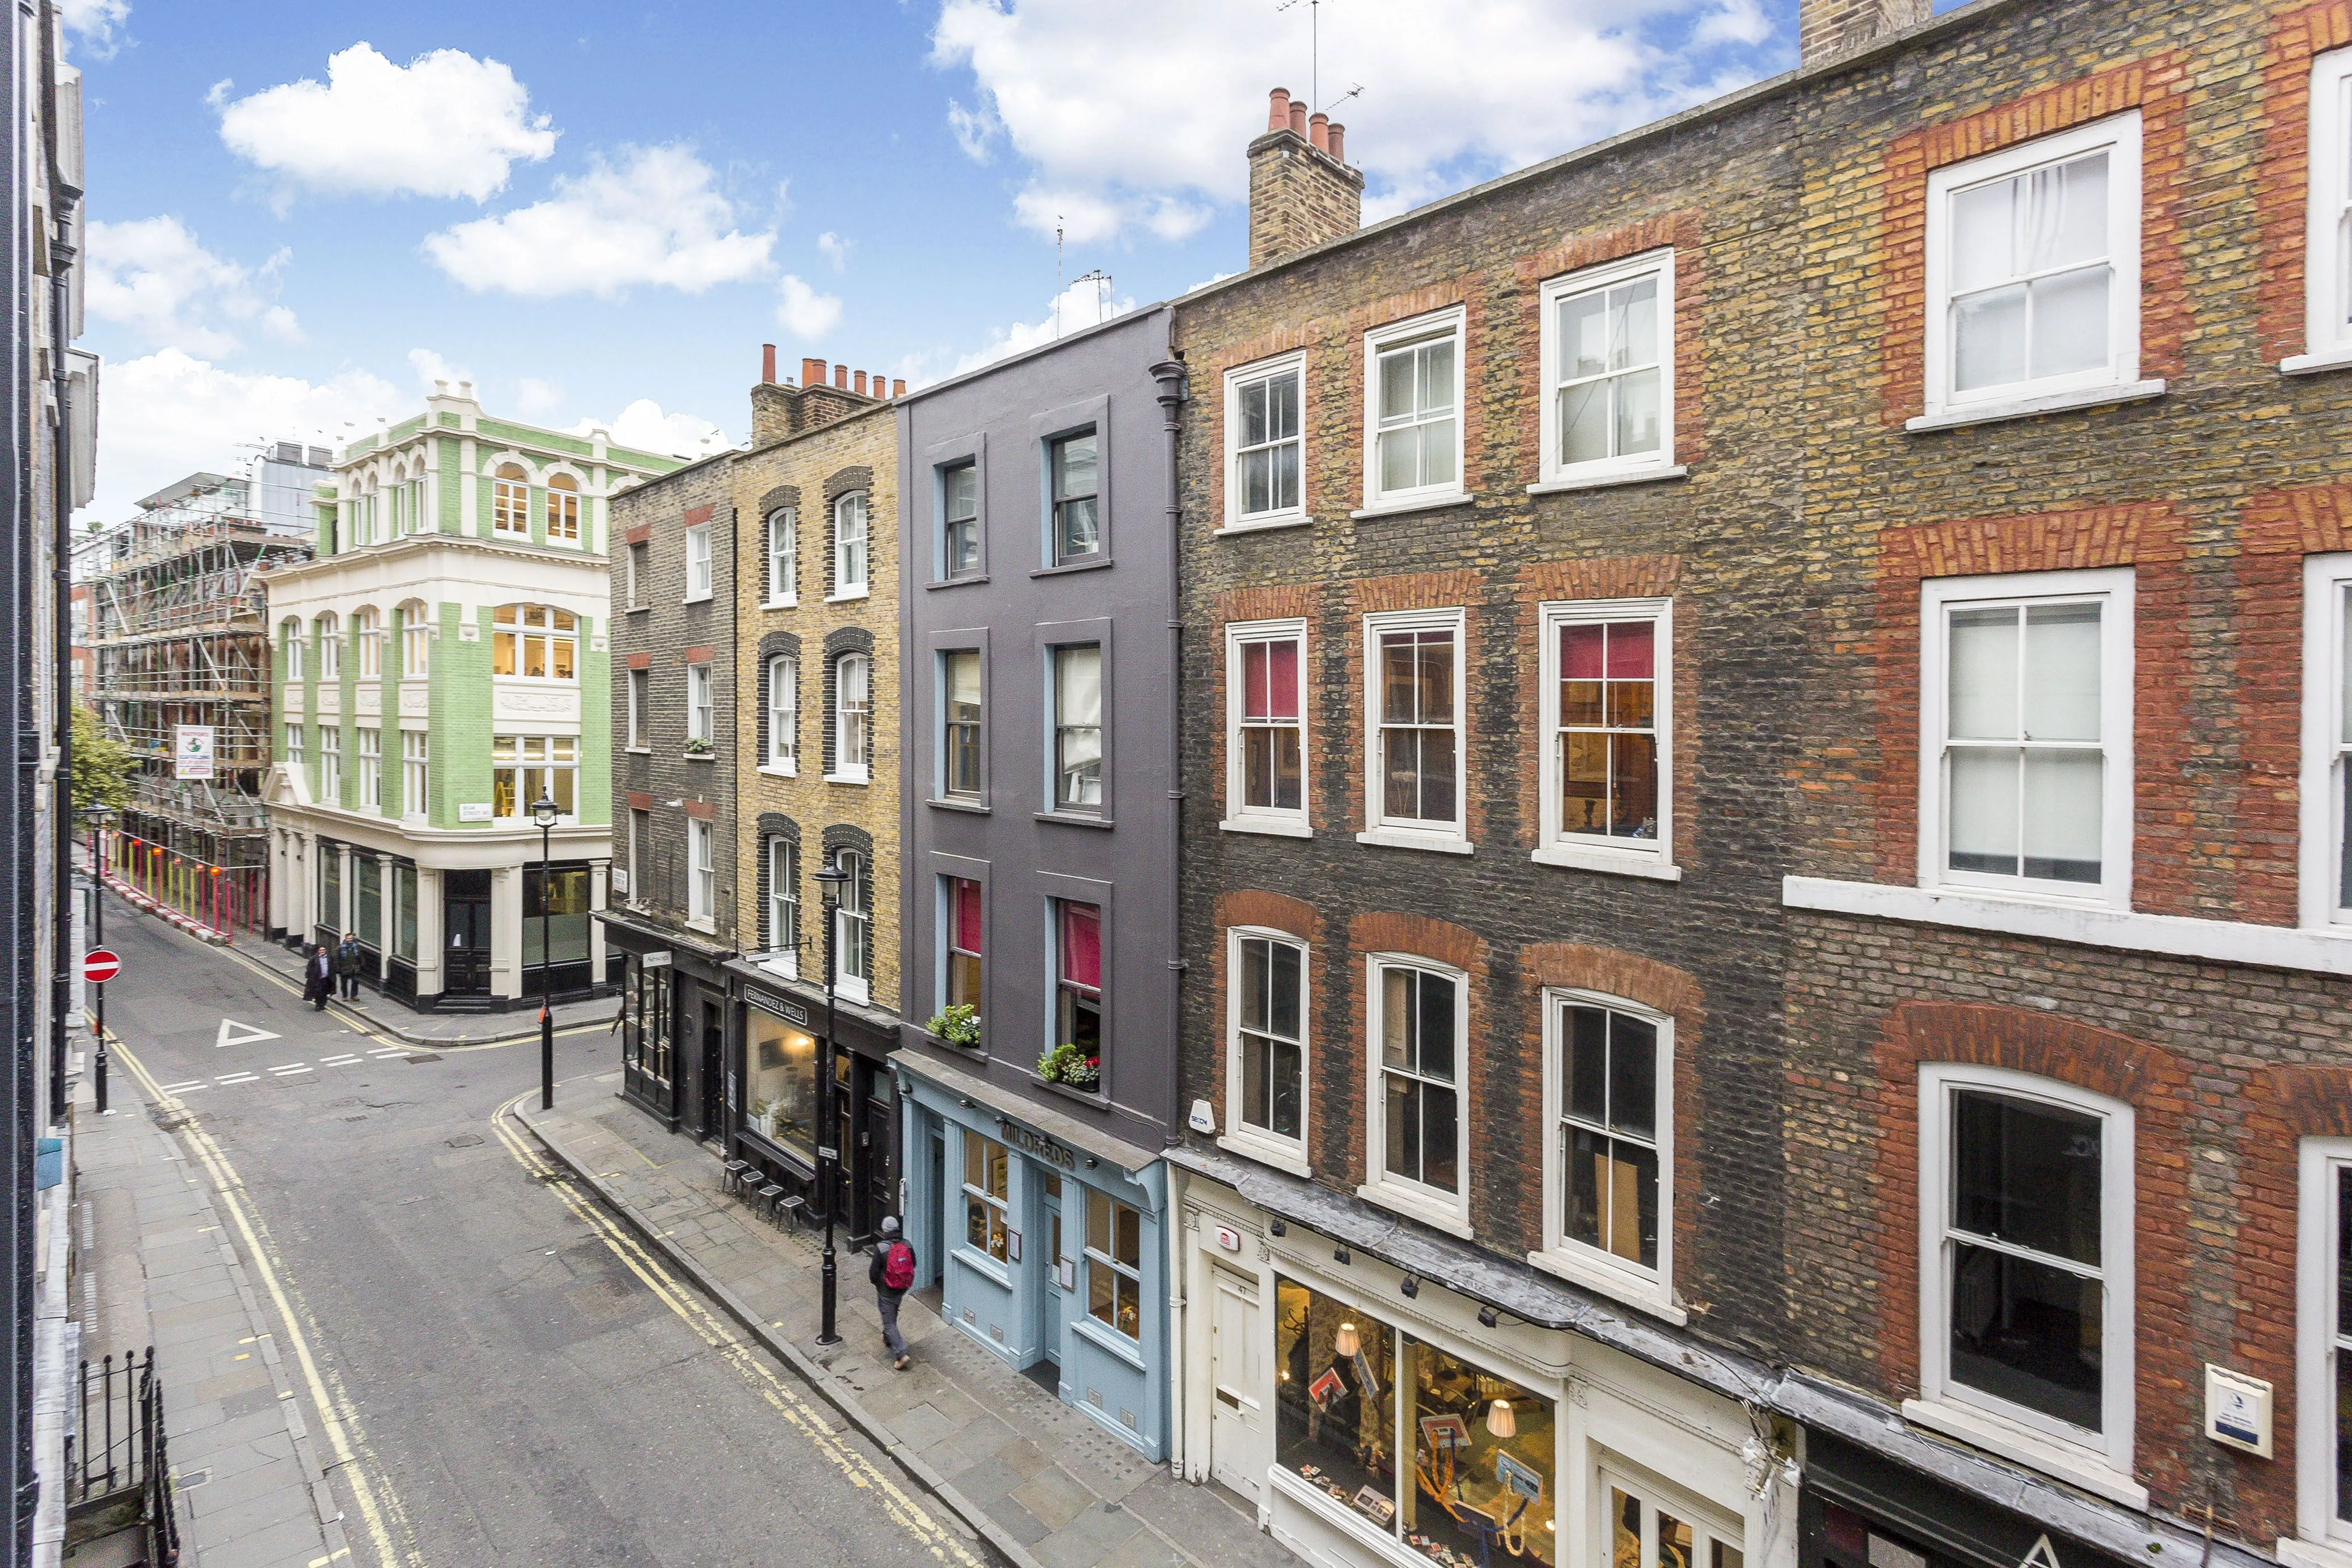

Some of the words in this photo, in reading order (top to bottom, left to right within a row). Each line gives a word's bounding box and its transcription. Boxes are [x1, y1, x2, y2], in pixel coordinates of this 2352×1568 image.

[747, 988, 779, 1010] FERNANDEZ
[784, 1004, 804, 1020] WELLS
[1000, 1122, 1076, 1171] MILDREDS
[1238, 1286, 1247, 1295] 47
